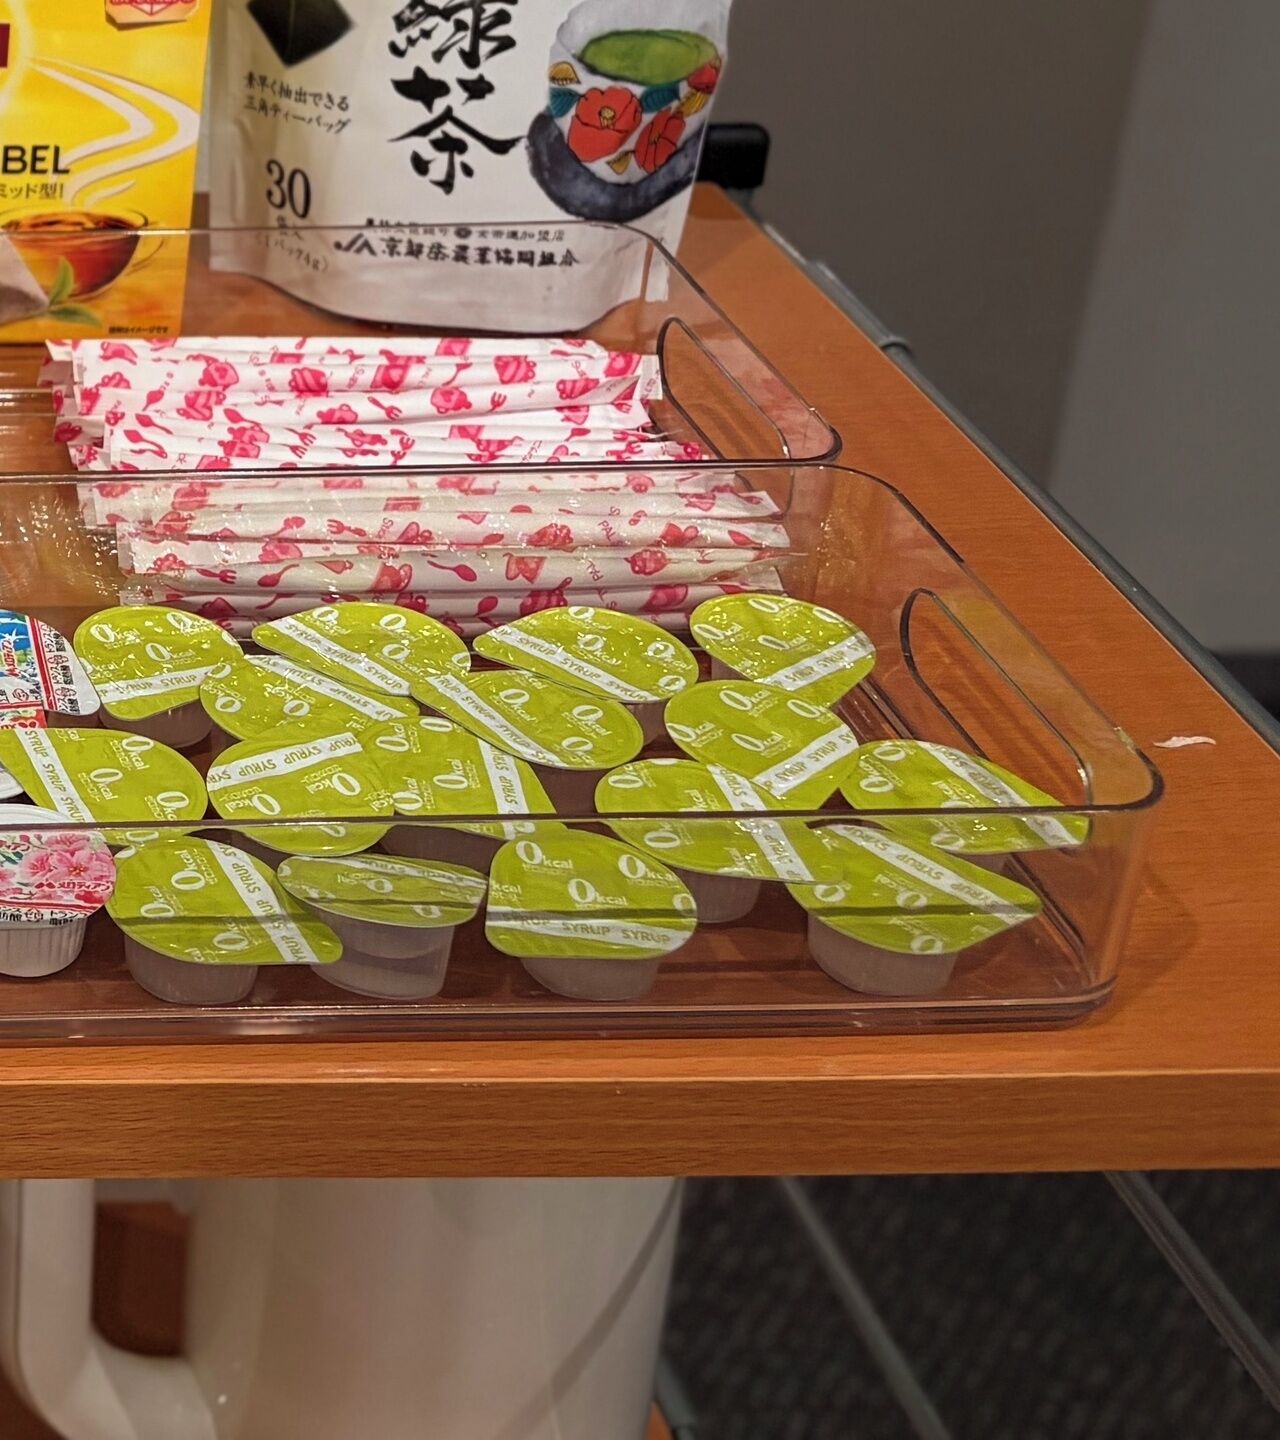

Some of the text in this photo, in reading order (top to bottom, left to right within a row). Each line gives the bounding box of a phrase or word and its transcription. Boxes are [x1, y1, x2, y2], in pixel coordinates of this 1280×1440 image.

[244, 71, 350, 111] 素早く抽出できる
[266, 159, 312, 220] 30
[286, 624, 322, 646] SYRUP
[365, 666, 403, 690] SYRUP
[560, 657, 601, 681] SYRUP
[25, 730, 49, 758] SYRUP
[283, 742, 323, 766] SYRUP
[808, 740, 840, 766] SYRUP
[42, 763, 68, 792] SYRUP
[237, 755, 277, 778] SYRUP
[231, 861, 262, 895] SYRUP
[562, 921, 611, 937] SYRUP
[622, 928, 672, 944] SYRUP
